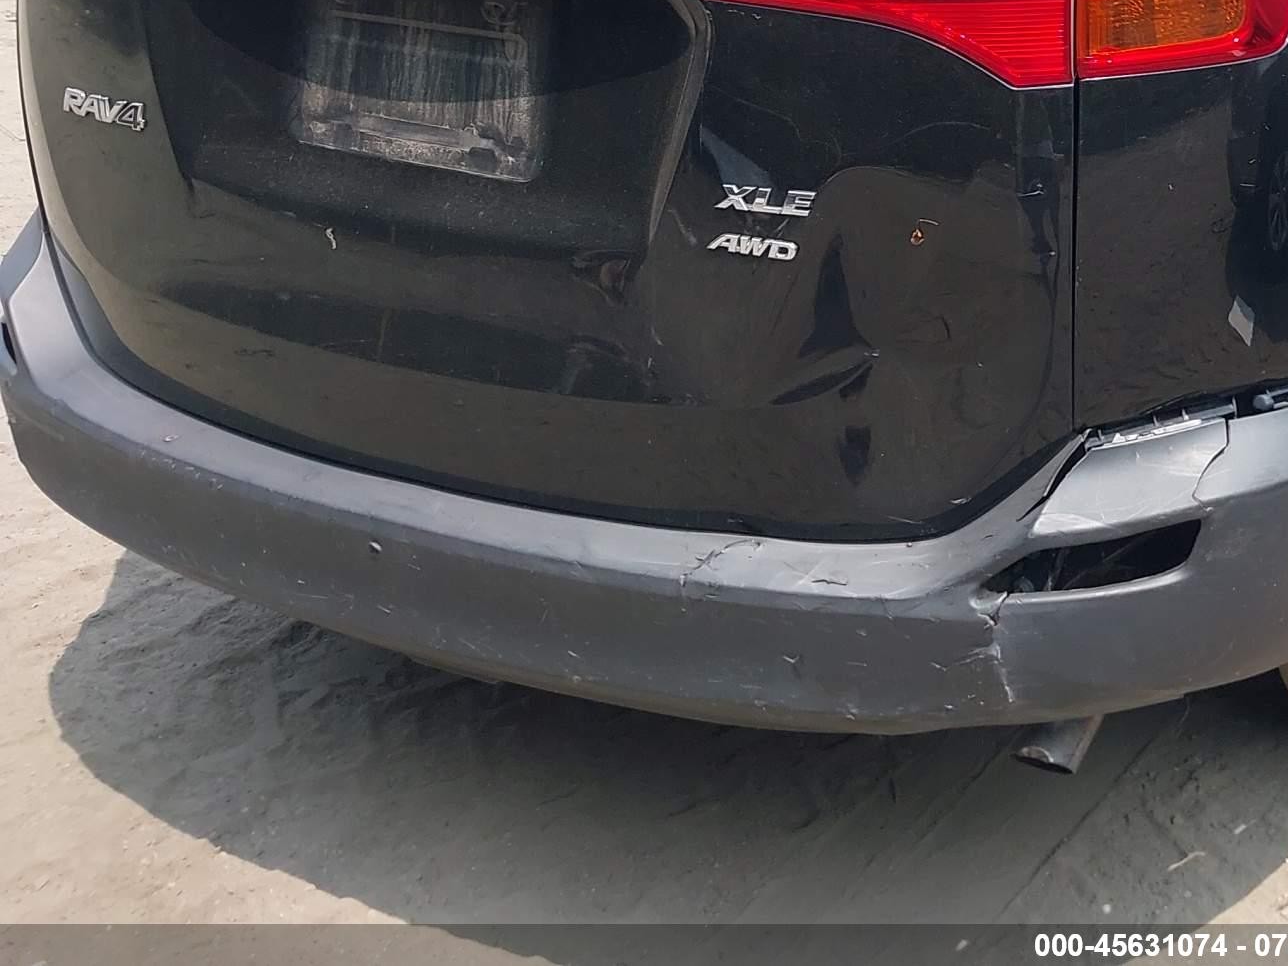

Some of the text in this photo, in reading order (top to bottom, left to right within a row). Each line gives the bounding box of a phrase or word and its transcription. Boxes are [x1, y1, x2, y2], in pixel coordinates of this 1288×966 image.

[63, 87, 146, 131] RAV4
[714, 184, 817, 216] XLE
[706, 233, 798, 260] AWD
